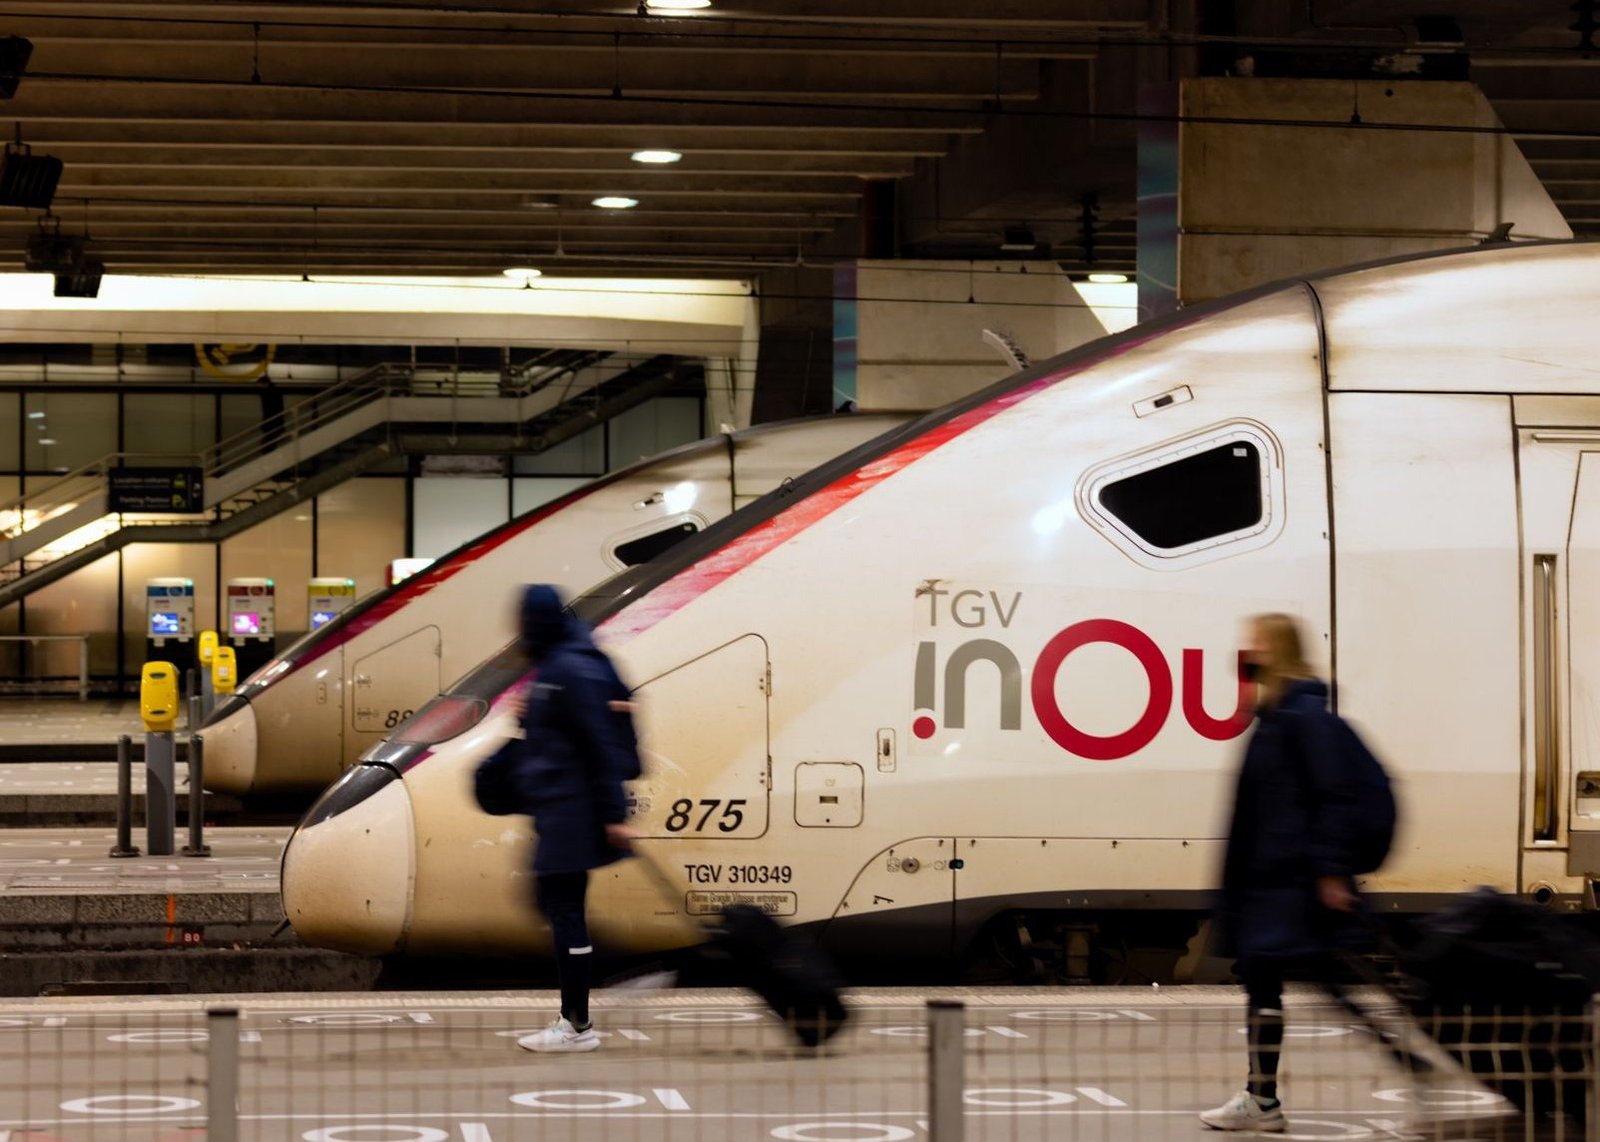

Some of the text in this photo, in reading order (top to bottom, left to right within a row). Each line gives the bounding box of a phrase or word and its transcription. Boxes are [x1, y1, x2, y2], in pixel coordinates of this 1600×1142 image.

[917, 589, 1022, 628] TGV
[665, 798, 746, 833] 875
[685, 864, 792, 884] TGV 310349
